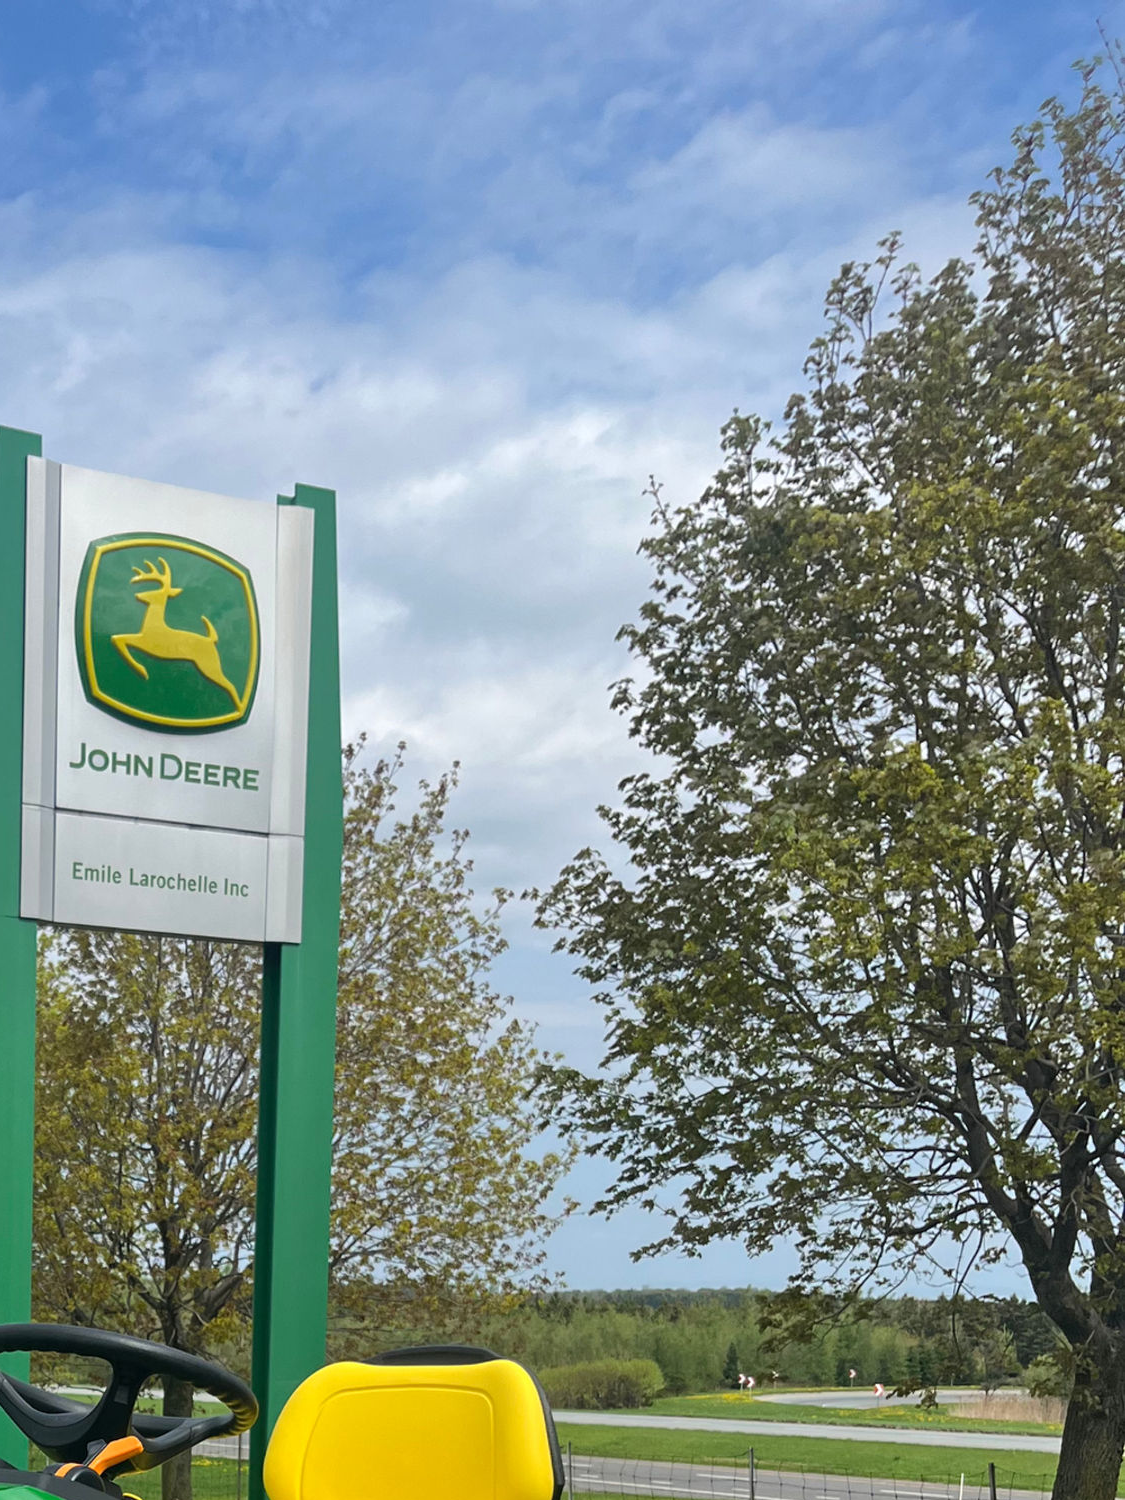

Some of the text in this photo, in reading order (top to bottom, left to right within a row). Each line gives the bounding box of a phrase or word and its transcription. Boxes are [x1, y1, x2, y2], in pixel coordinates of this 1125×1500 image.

[69, 742, 260, 792] JOHN DEERE
[71, 861, 250, 898] Emile Larochelle Inc
